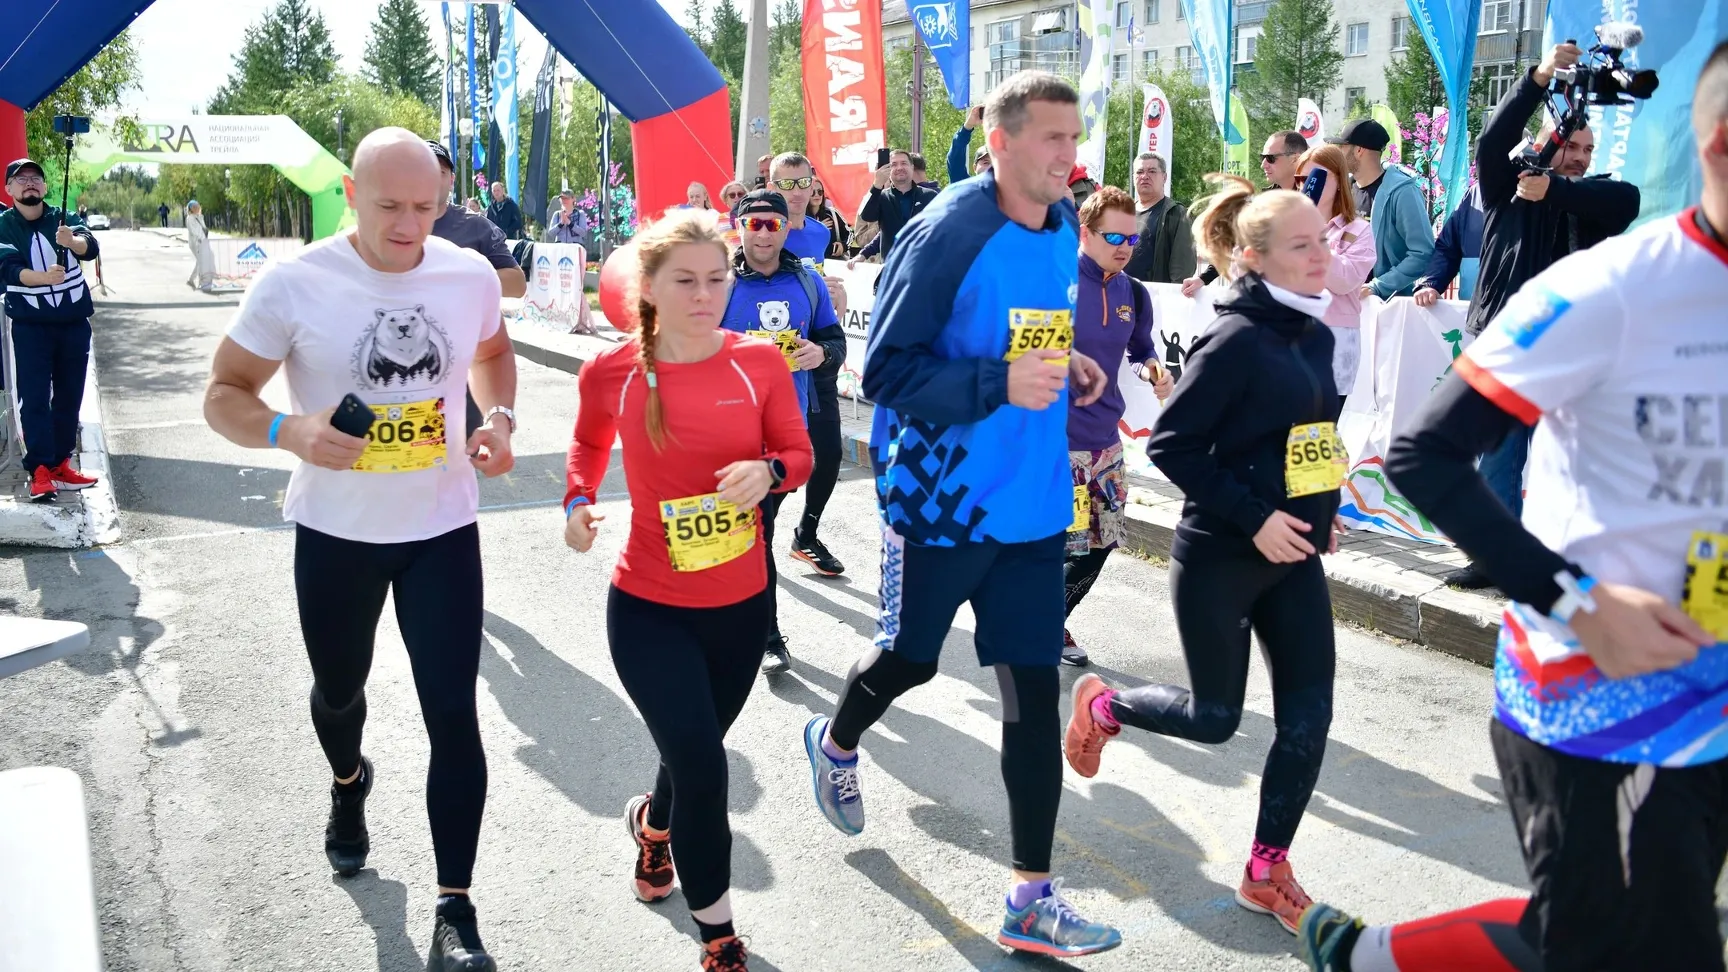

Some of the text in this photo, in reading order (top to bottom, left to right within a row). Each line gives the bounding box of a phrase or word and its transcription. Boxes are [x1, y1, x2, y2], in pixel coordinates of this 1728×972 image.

[209, 135, 261, 143] АССОЦИАЦИЯ
[1018, 328, 1056, 349] 567
[1635, 396, 1728, 447] СЕ
[1291, 439, 1332, 465] 566
[676, 510, 731, 540] 505
